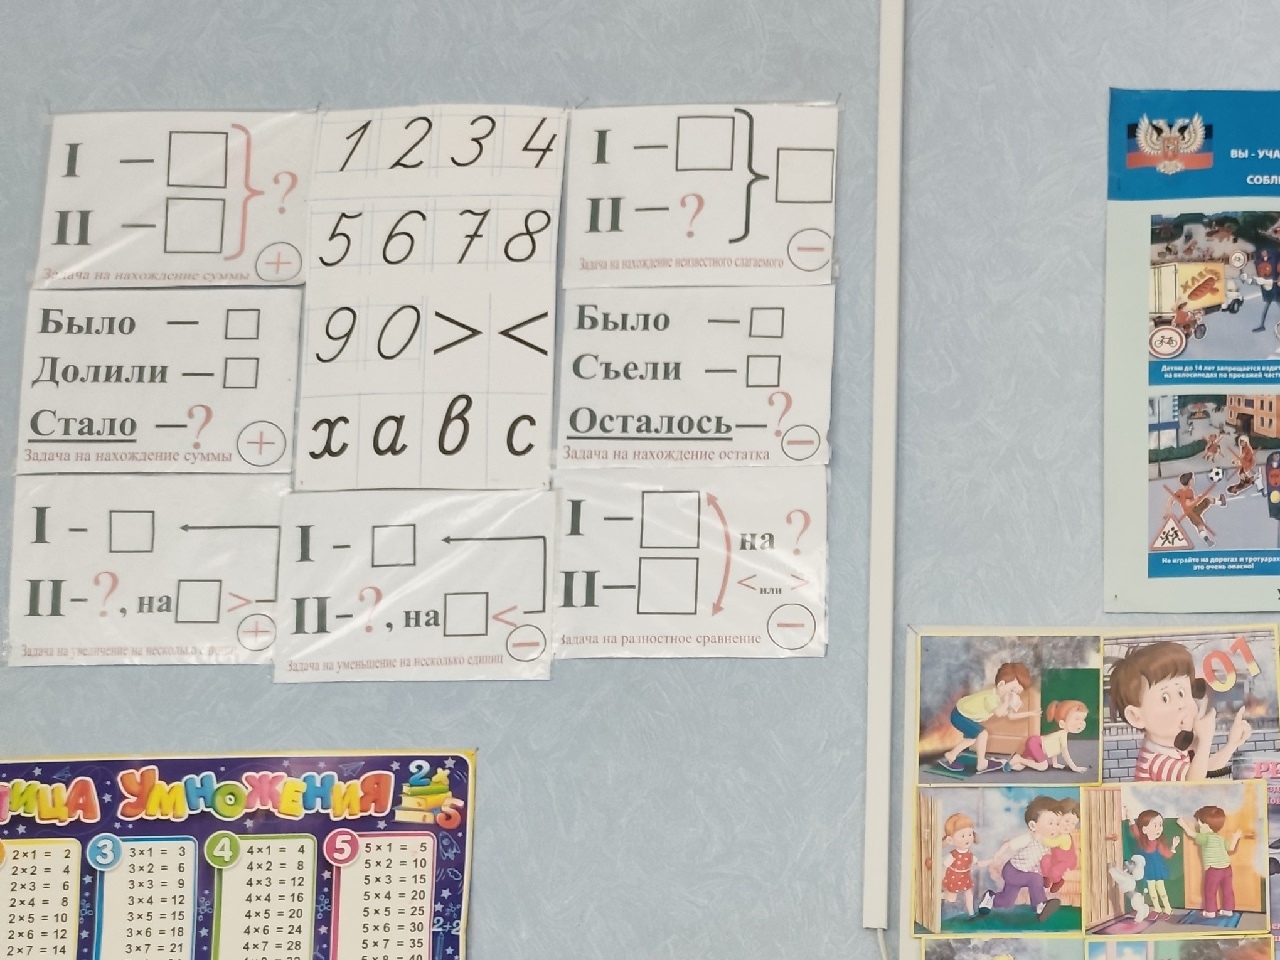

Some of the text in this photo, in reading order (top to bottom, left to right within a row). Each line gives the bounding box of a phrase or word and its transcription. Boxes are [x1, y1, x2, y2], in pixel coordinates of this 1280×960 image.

[340, 115, 557, 171] 1 2 3 4
[1230, 149, 1248, 159] ВЫ
[319, 208, 551, 267] 5 6 7 8
[38, 308, 136, 335] Было
[576, 304, 670, 331] Было
[316, 305, 421, 363] 9 0
[31, 356, 169, 388] Долили
[572, 353, 681, 380] Съели
[29, 409, 137, 437] Стало
[569, 407, 733, 436] Осталось
[24, 449, 232, 464] Задача на нахождение суммы
[739, 531, 775, 551] на
[760, 585, 782, 595] или
[137, 595, 173, 613] на
[403, 609, 440, 628] на
[1203, 636, 1261, 693] 01
[118, 767, 394, 822] УМНОЖЕНИЯ
